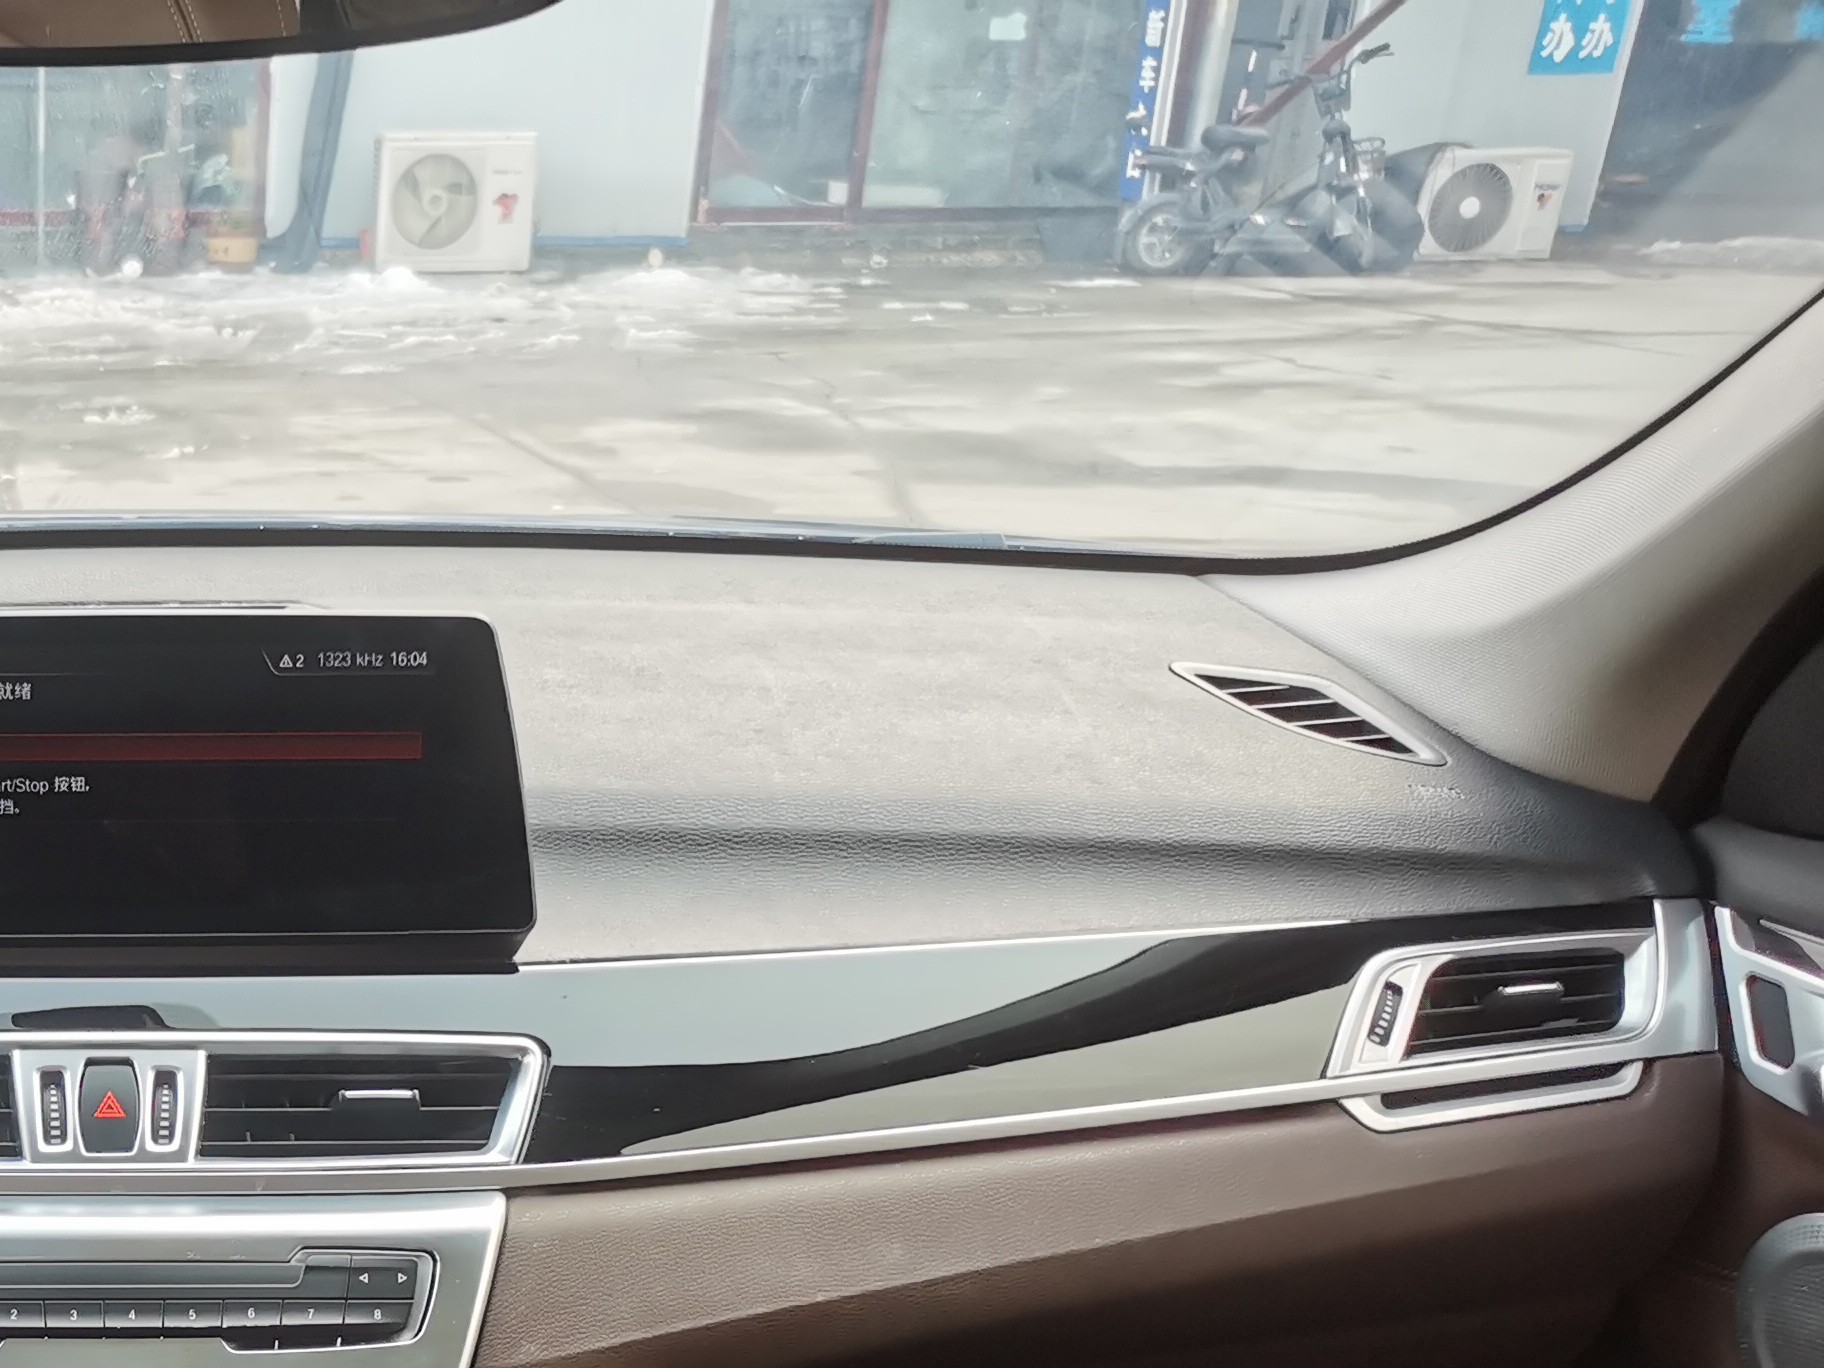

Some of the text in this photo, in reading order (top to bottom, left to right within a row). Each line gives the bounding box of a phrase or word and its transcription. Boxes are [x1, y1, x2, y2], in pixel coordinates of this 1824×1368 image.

[295, 653, 306, 668] 2
[316, 650, 384, 668] 1323 kHz
[389, 650, 428, 668] 16:04
[9, 1308, 19, 1322] 2
[68, 1308, 79, 1322] 3
[127, 1308, 137, 1322] 4
[187, 1307, 197, 1321] 5
[246, 1306, 256, 1320] 6
[305, 1307, 315, 1321] 7
[373, 1307, 383, 1321] 8
